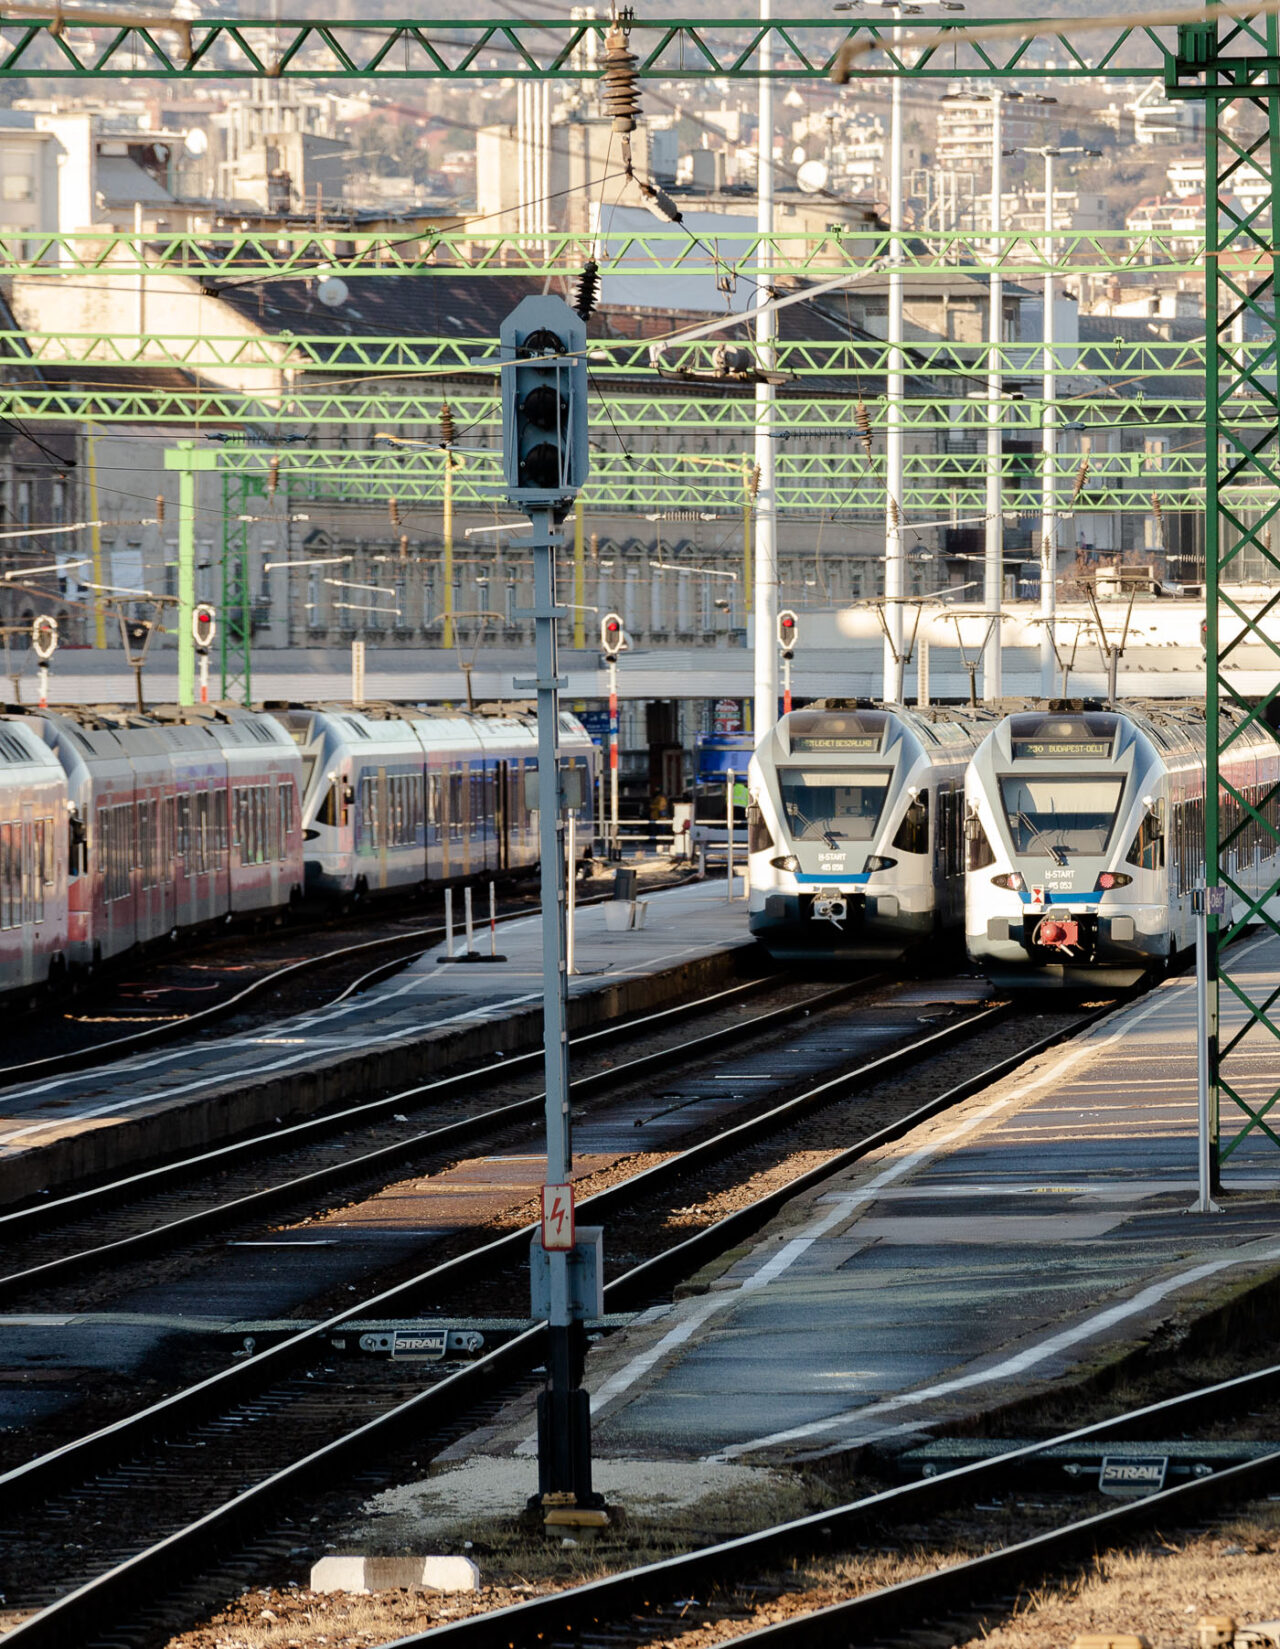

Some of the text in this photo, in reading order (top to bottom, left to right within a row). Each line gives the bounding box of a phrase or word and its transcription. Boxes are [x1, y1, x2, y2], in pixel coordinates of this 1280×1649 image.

[1044, 870, 1076, 879] H-START
[395, 1338, 445, 1349] STRAIL
[1104, 1465, 1163, 1479] STRAIL
